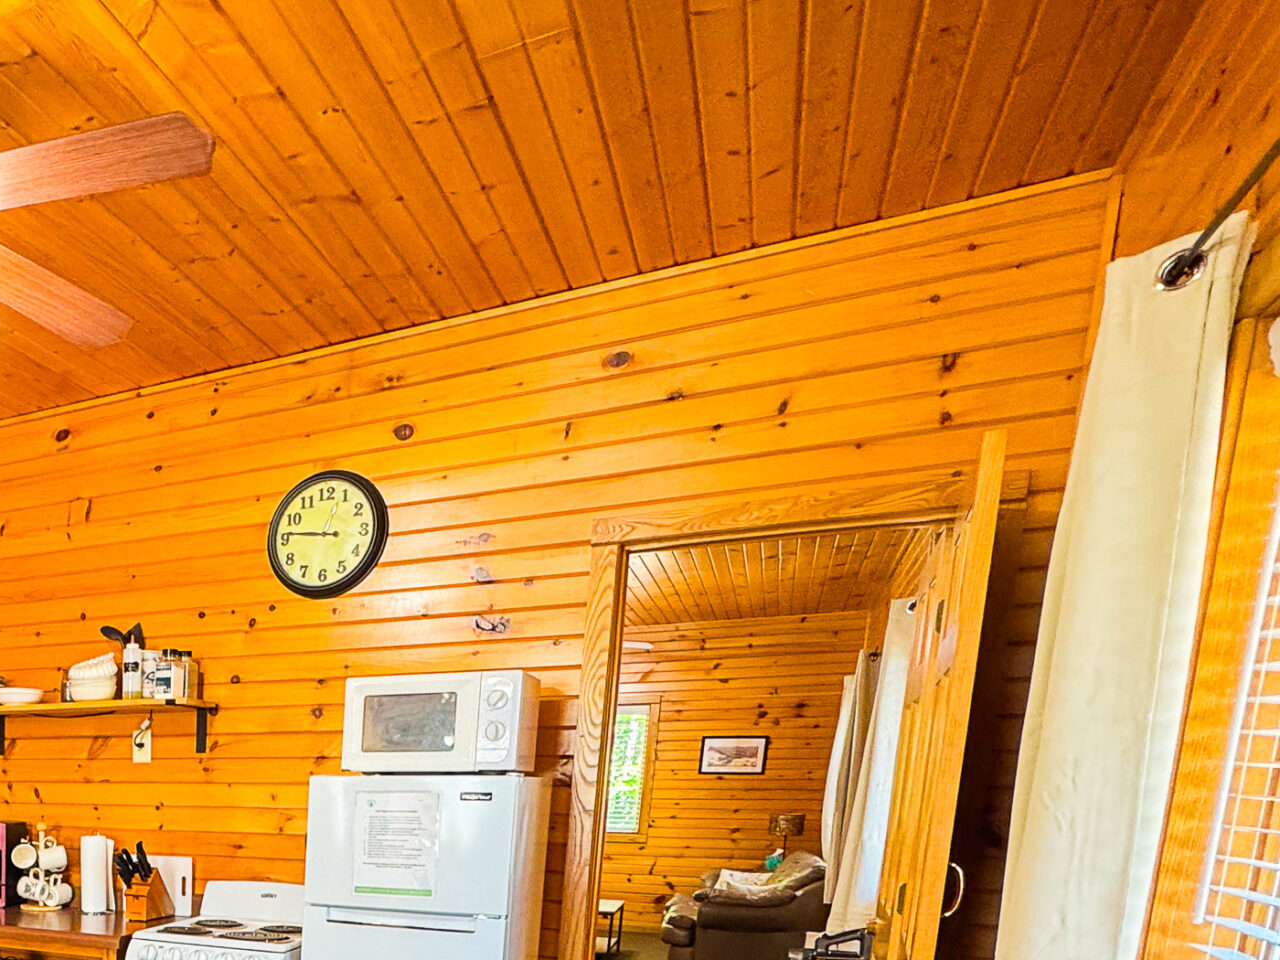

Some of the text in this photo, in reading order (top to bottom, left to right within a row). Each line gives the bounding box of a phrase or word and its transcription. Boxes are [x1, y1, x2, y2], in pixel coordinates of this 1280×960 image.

[318, 487, 335, 501] 12
[342, 489, 349, 502] 1
[300, 496, 313, 509] 11
[353, 503, 363, 516] 2
[286, 513, 301, 526] 10
[359, 523, 369, 536] 3
[281, 533, 290, 546] 9
[351, 544, 360, 556] 4
[286, 553, 295, 565] 8
[300, 565, 308, 578] 7
[336, 561, 346, 573] 5
[318, 569, 327, 582] 6
